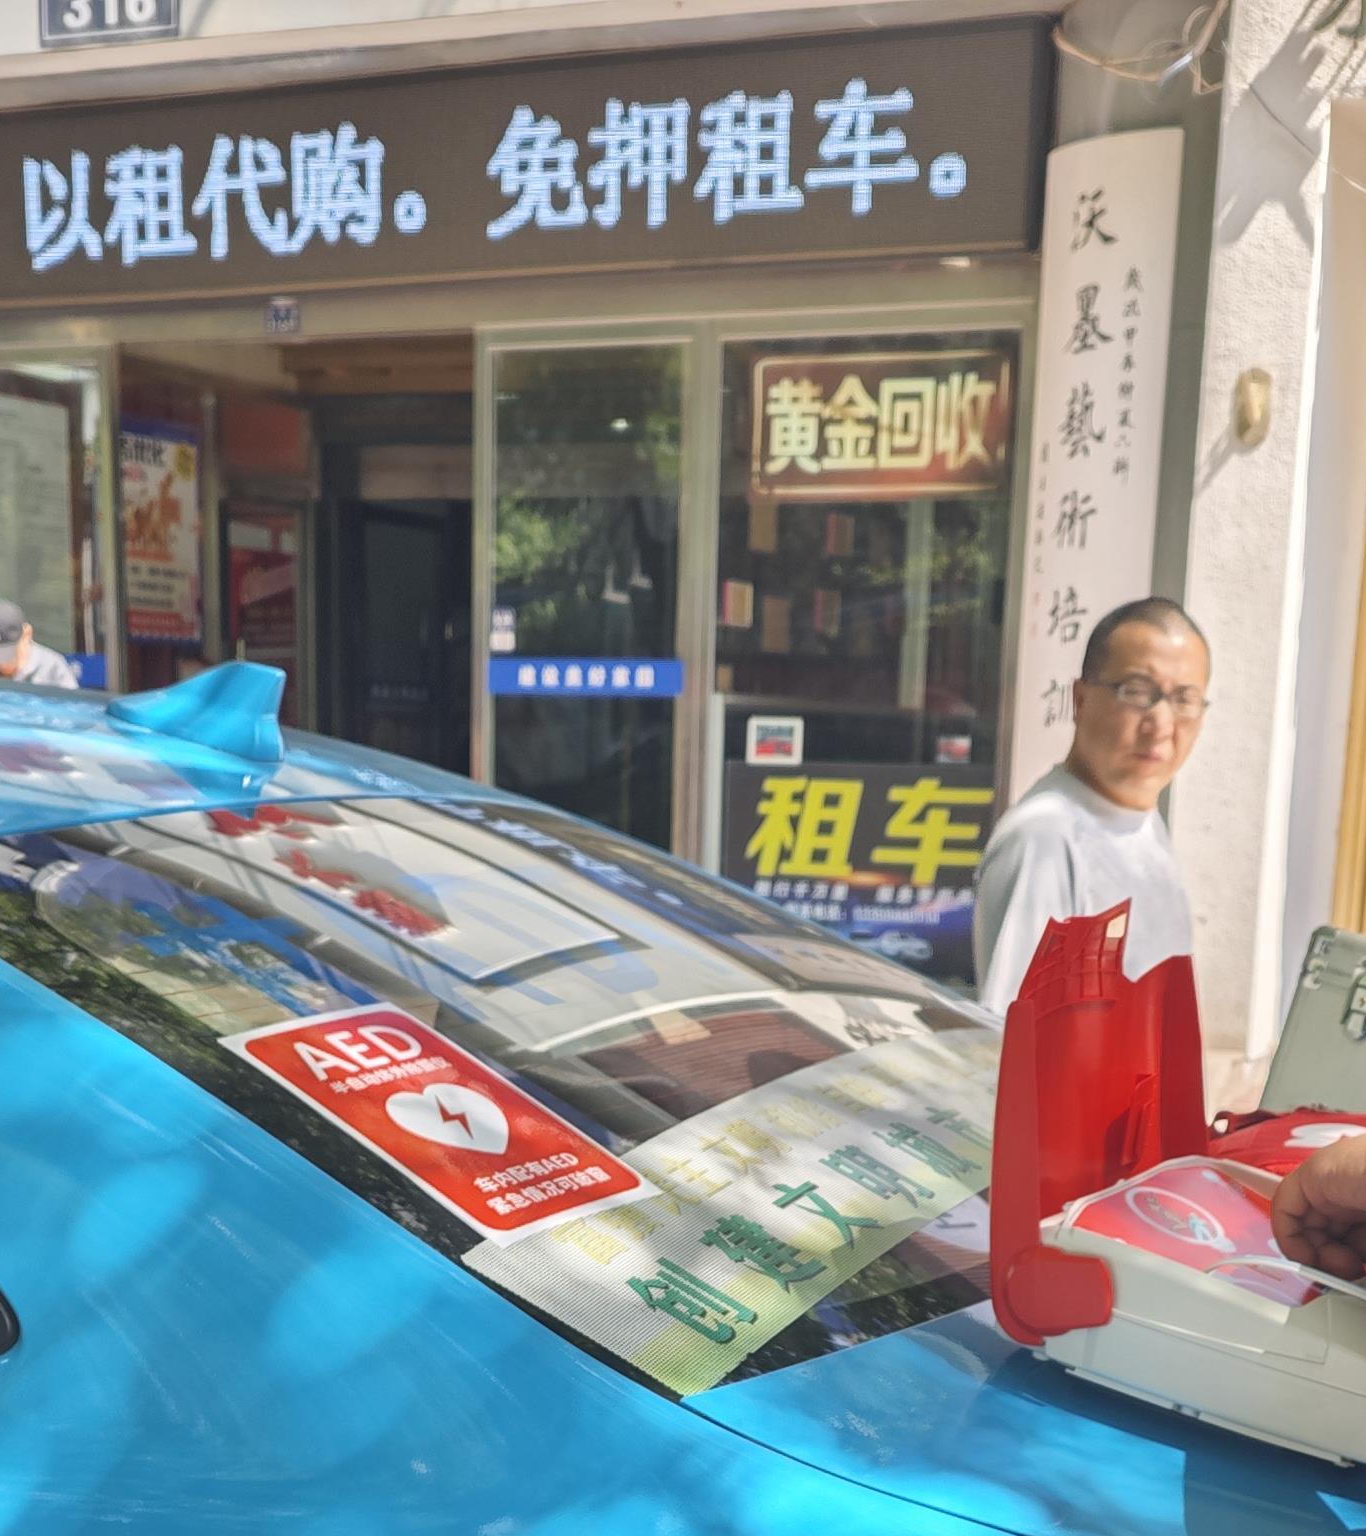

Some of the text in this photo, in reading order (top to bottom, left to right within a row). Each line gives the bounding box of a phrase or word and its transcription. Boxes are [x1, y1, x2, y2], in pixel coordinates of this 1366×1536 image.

[765, 372, 997, 475] 黄金回收
[744, 775, 995, 887] 租车
[293, 1025, 422, 1082] AED
[473, 1152, 579, 1193] 车内配有AED
